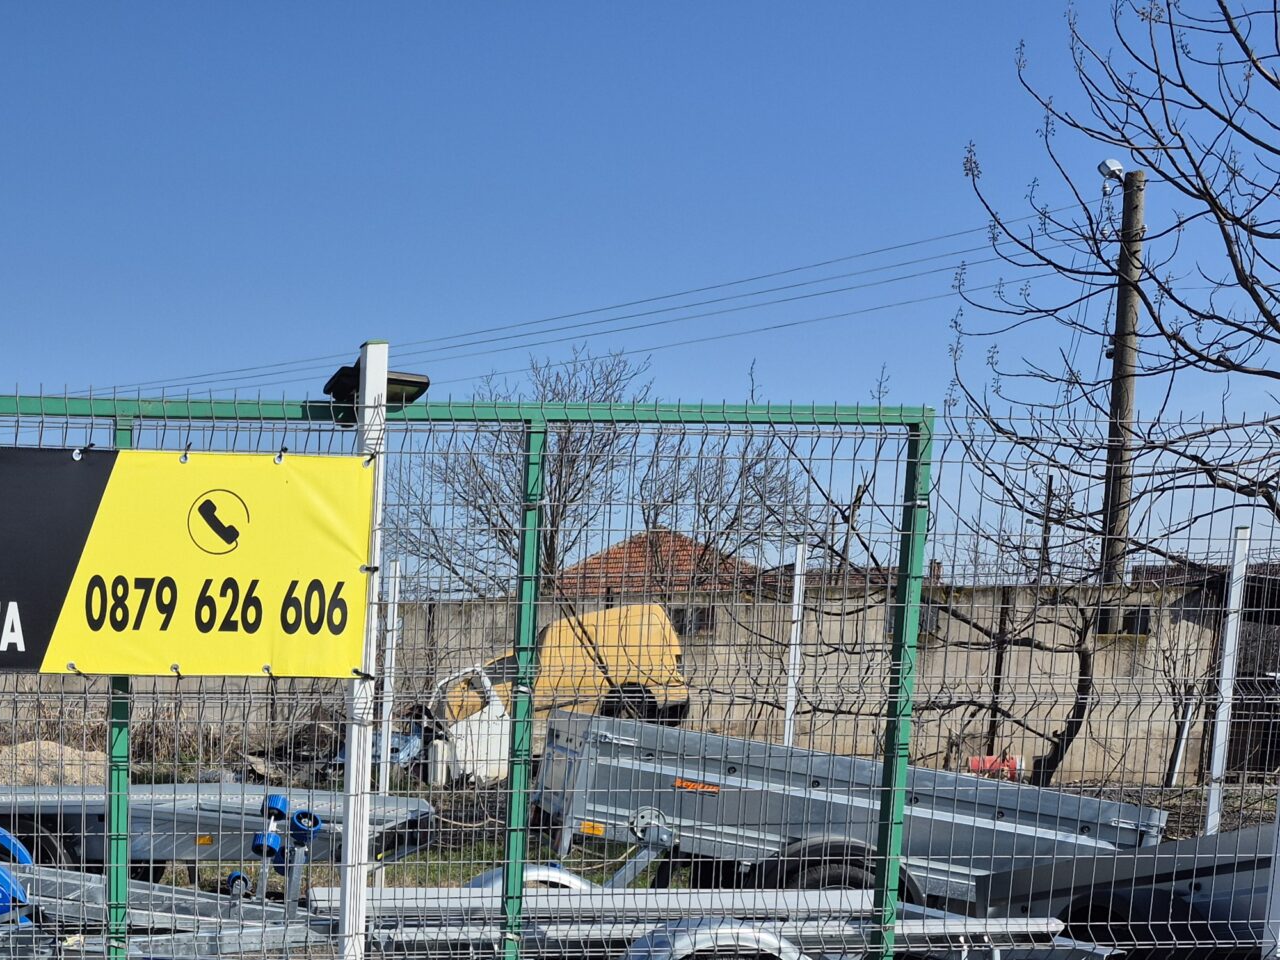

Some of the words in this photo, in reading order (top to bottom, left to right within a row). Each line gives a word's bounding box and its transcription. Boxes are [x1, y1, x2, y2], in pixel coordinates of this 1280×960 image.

[85, 574, 178, 633] 0879
[194, 576, 263, 634] 626
[280, 578, 348, 636] 606
